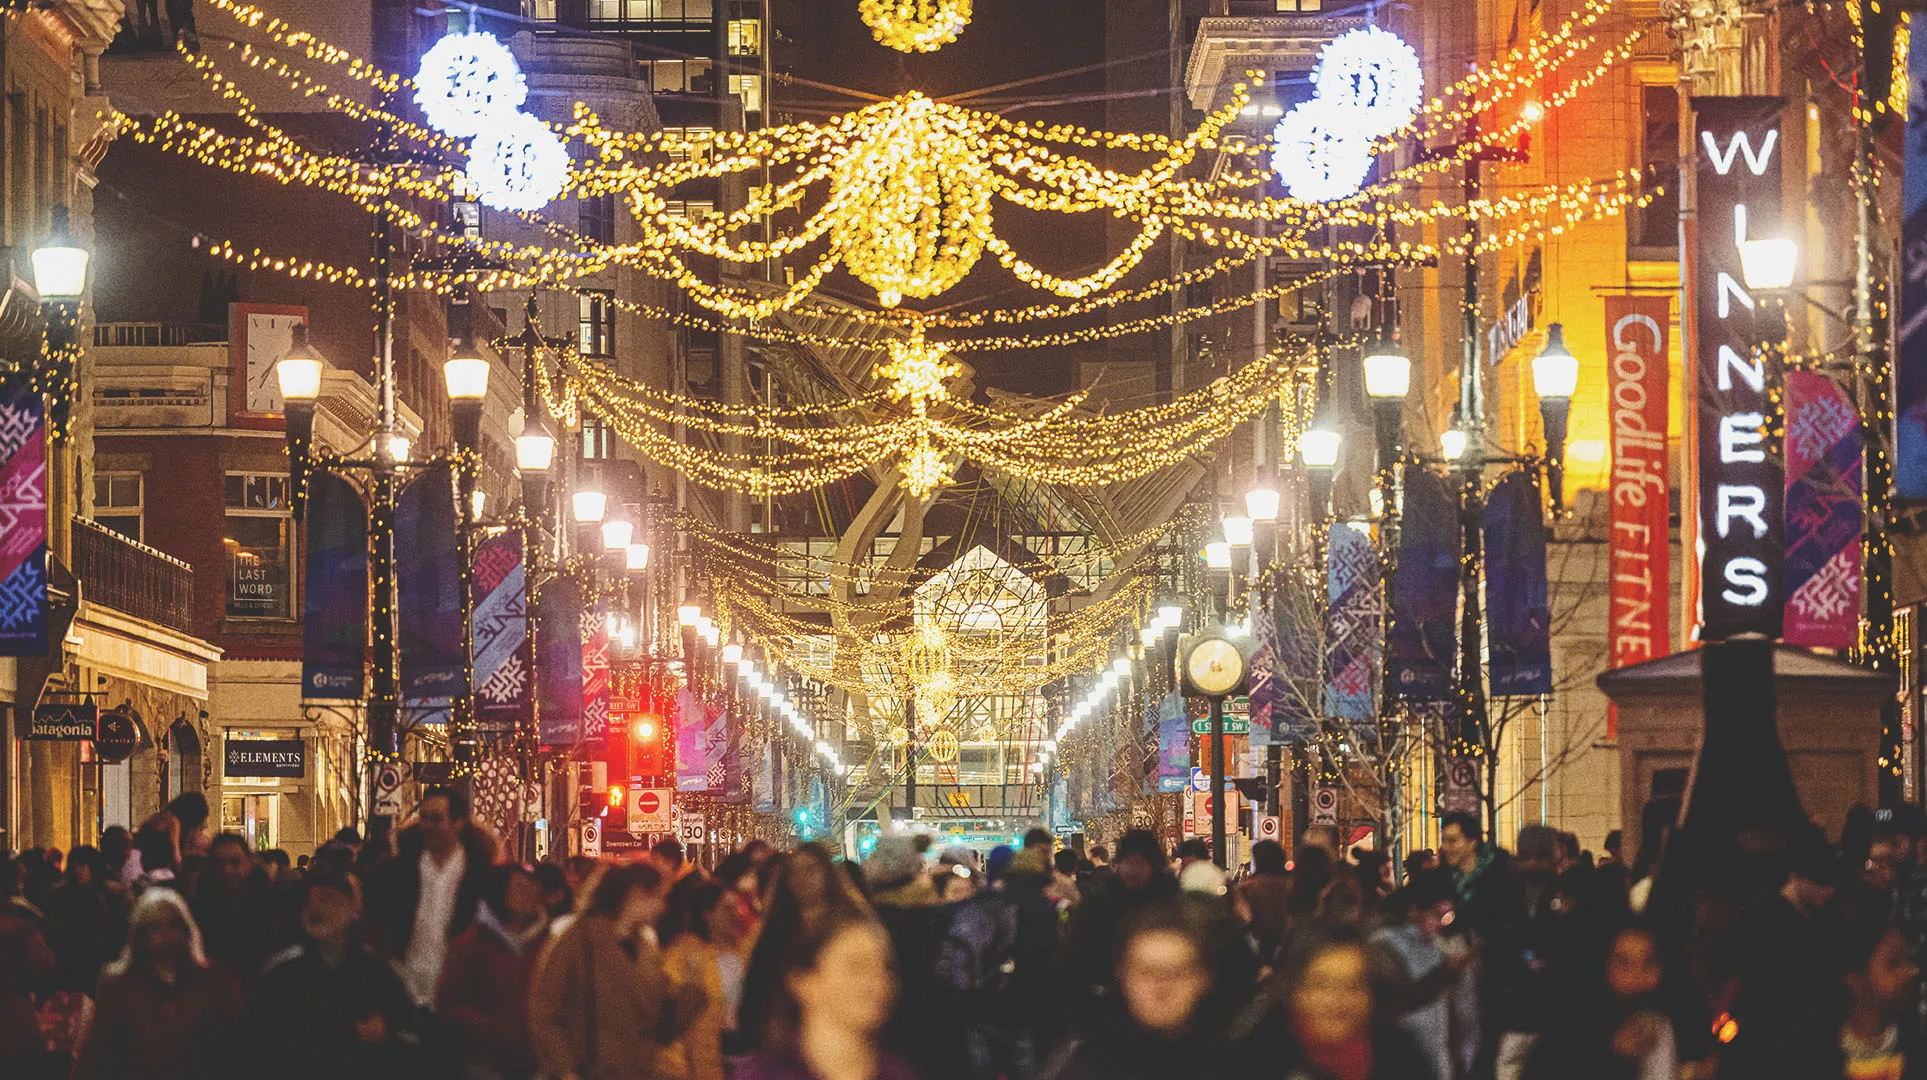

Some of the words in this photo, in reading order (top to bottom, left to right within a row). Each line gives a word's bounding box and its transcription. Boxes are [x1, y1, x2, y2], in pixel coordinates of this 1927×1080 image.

[1701, 129, 1778, 607] WINNERS
[1613, 313, 1665, 507] GoodLife
[239, 555, 260, 567] THE
[239, 570, 267, 580] LAST
[239, 584, 273, 595] WORD
[1614, 521, 1652, 669] FITNE
[1231, 702, 1249, 710] STREE
[1231, 722, 1244, 731] SW
[240, 752, 300, 763] ELEMENTS
[683, 825, 703, 839] 30
